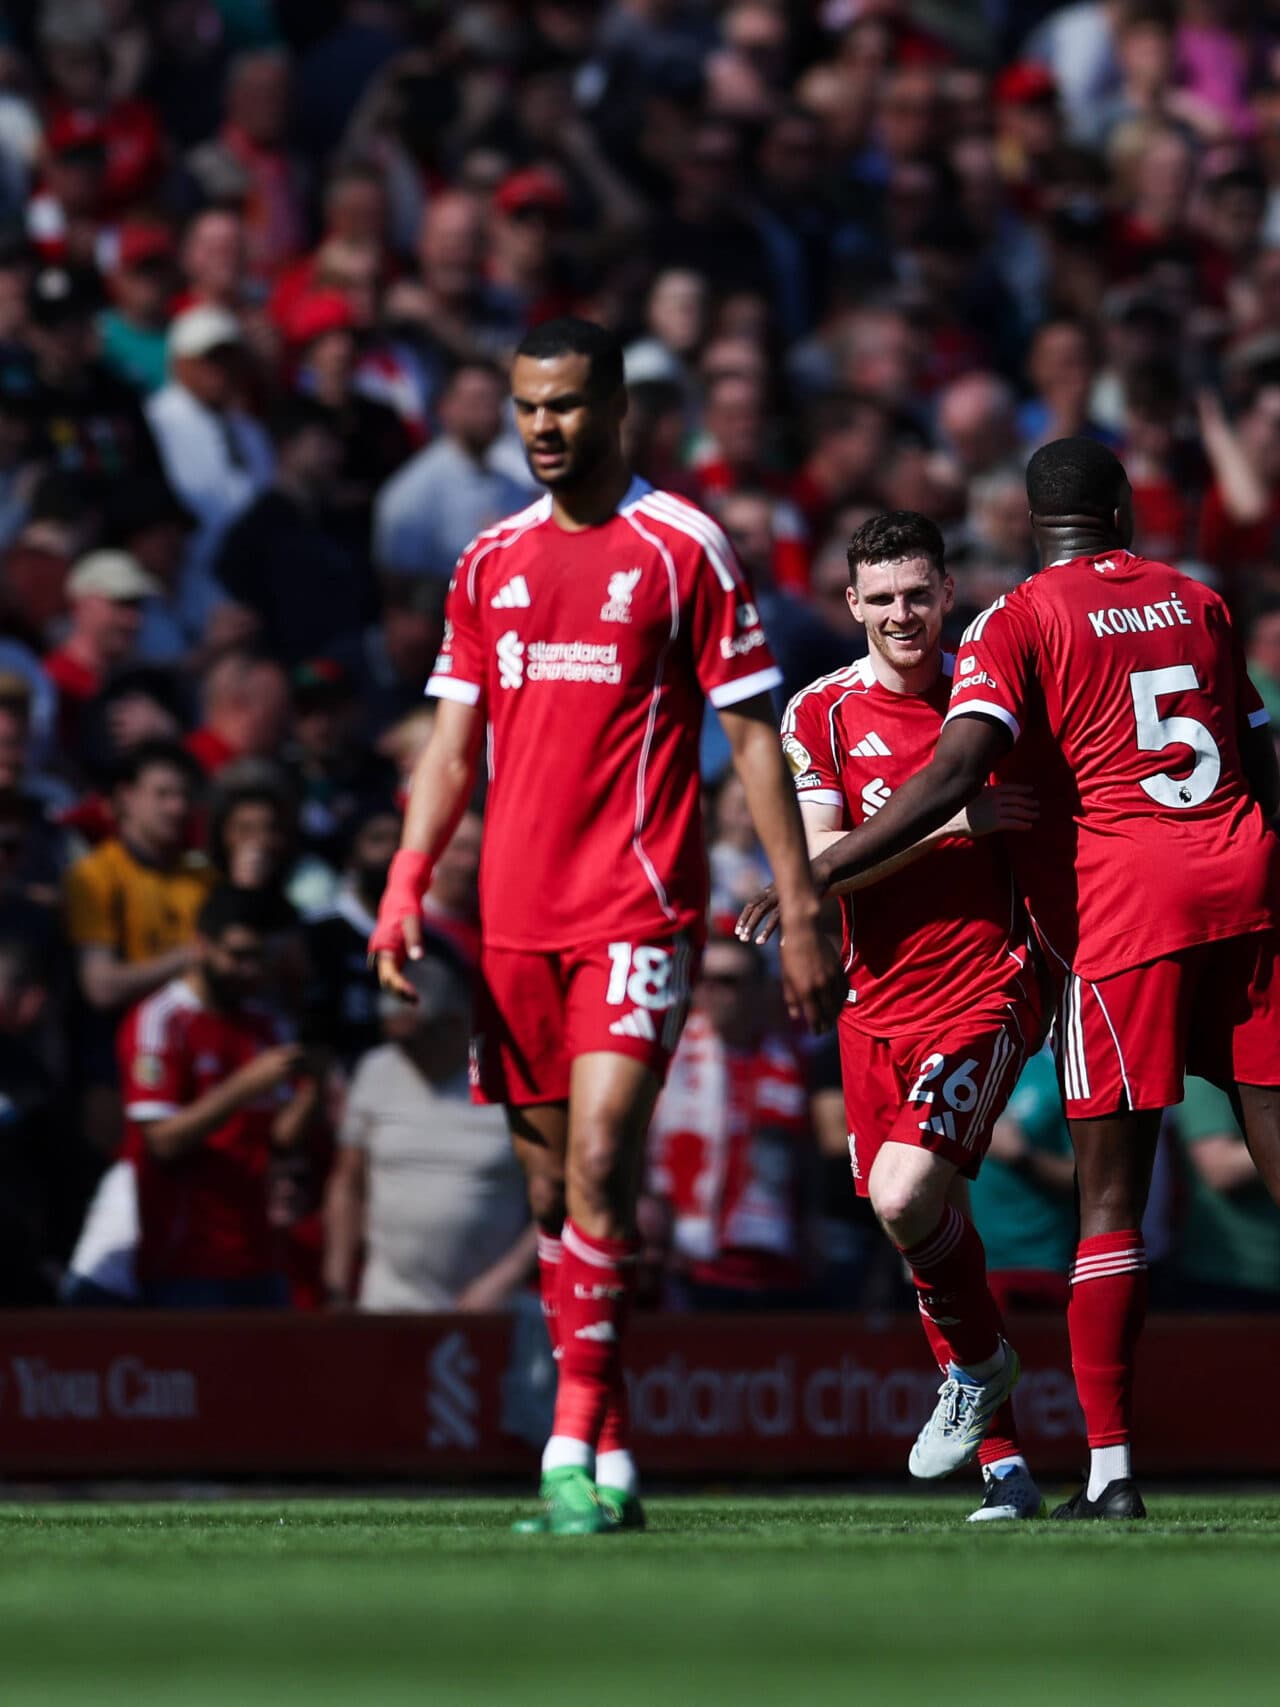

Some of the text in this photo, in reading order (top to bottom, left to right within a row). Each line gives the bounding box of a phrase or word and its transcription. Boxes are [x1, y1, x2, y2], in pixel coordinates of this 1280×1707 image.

[1088, 592, 1192, 637] KONATÉ
[527, 640, 618, 664] standard
[1130, 664, 1222, 809] 5
[606, 942, 676, 1010] 18
[907, 1052, 980, 1113] 26
[11, 1356, 99, 1419] You
[106, 1354, 199, 1418] Can
